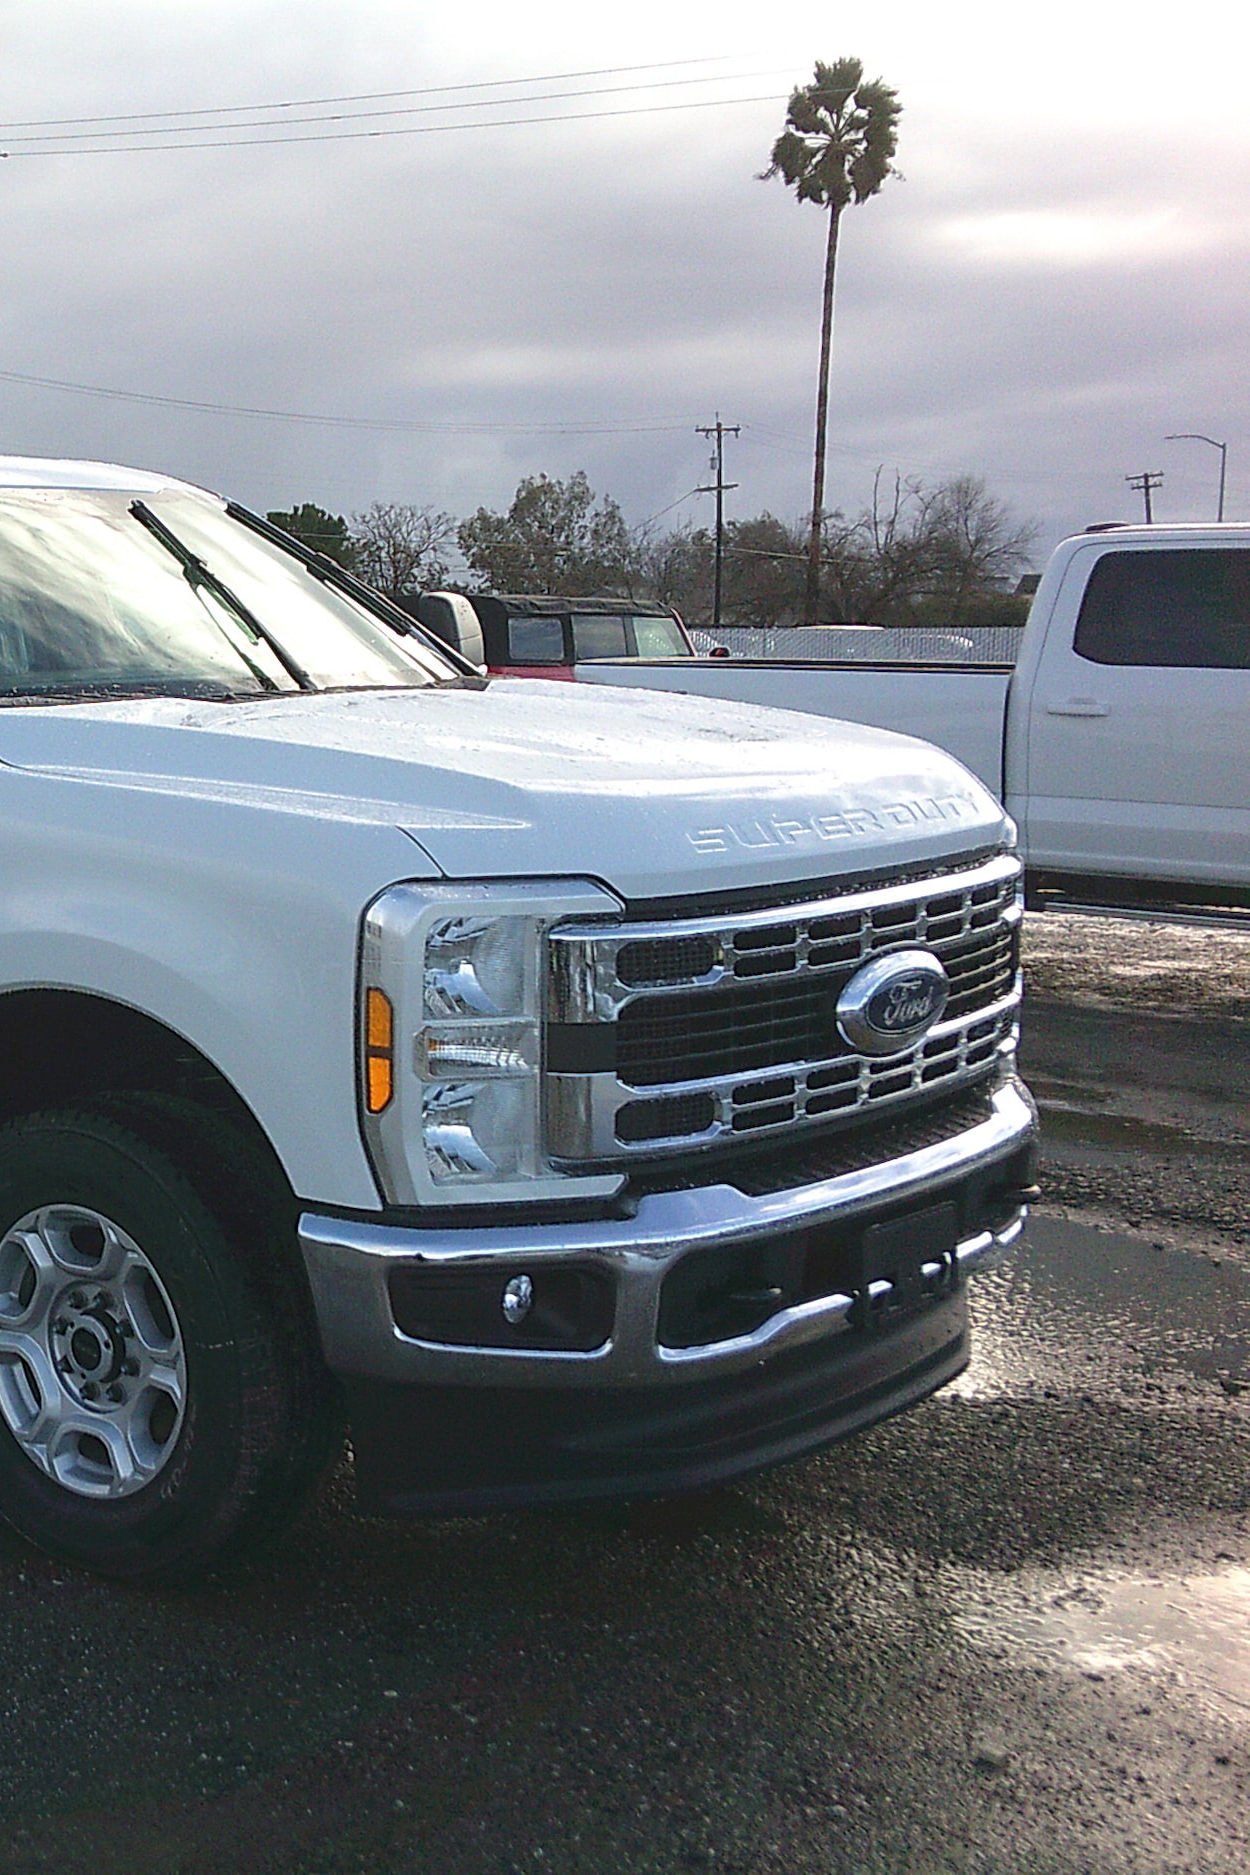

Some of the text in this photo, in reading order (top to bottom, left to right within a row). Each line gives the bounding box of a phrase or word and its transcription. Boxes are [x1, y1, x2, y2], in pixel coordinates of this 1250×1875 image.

[686, 792, 980, 853] SUPER DUTY
[883, 979, 934, 1026] Ford
